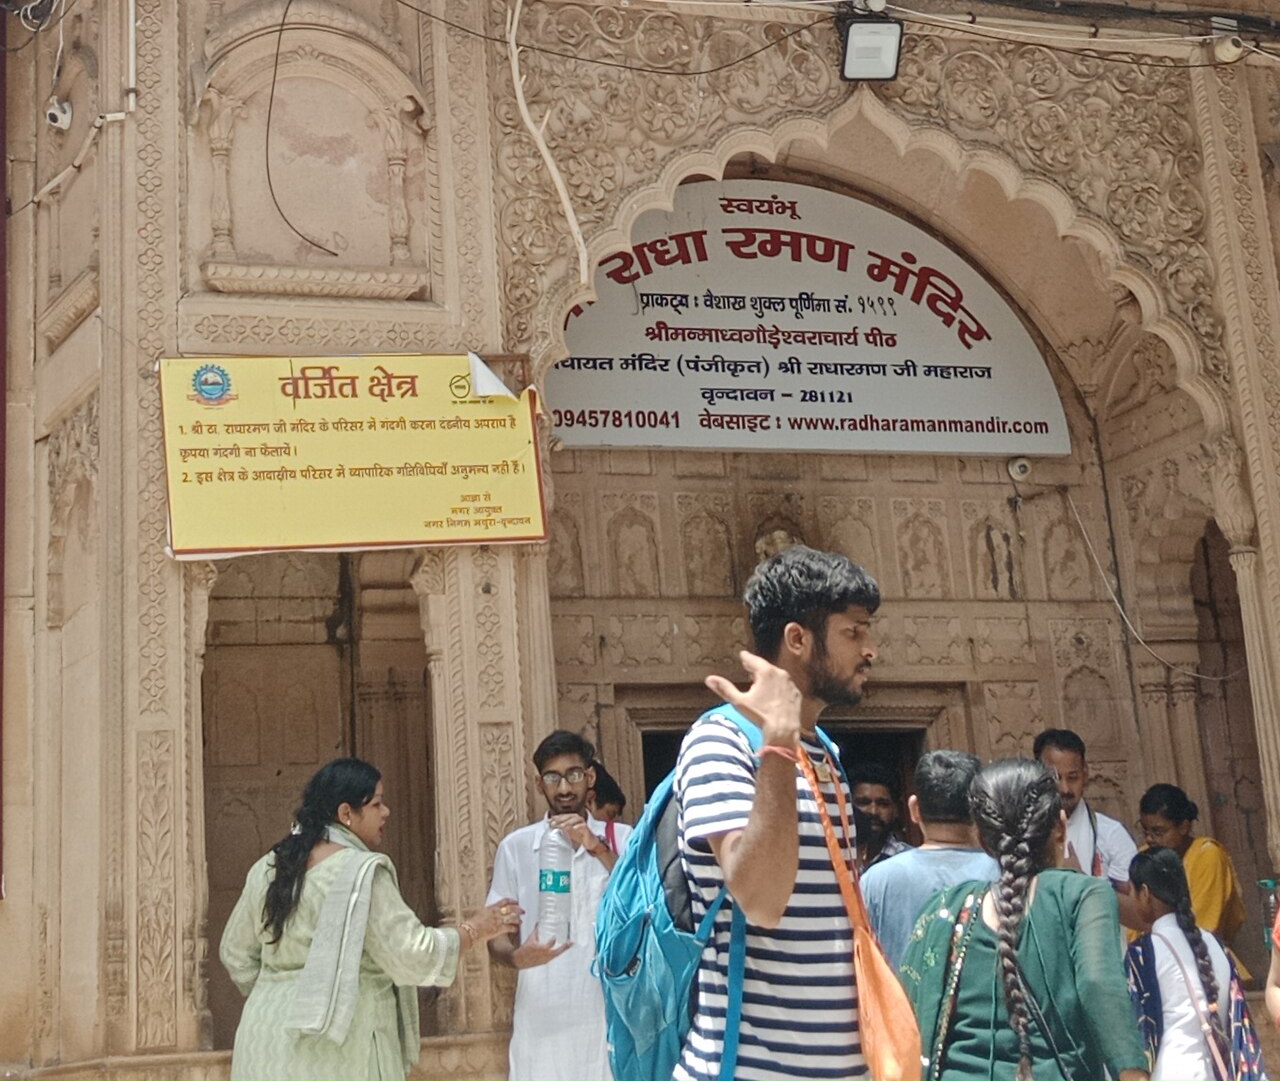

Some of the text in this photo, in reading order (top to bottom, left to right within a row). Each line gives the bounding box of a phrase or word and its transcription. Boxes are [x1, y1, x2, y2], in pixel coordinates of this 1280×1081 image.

[719, 194, 801, 219] स्वयंभू
[598, 227, 992, 350] राधा रमण मंदिर
[750, 295, 786, 317] शुक्ल
[864, 327, 898, 348] पीठ
[619, 353, 671, 371] मंदिर
[677, 353, 769, 378] (पंजीकृत)
[778, 360, 802, 376] श्री
[893, 360, 919, 378] जी
[923, 364, 992, 380] महाराज
[278, 366, 359, 401] वर्जित
[368, 366, 419, 402] क्षेत्र
[699, 387, 775, 405] वृन्दावन
[800, 390, 853, 403] 281121
[179, 425, 187, 435] 1.
[273, 419, 287, 433] जी
[319, 418, 328, 431] के
[332, 417, 364, 432] परिसर
[699, 408, 771, 433] वेबसाइट
[788, 414, 1049, 435] www.radharamanmandir.com
[182, 472, 192, 482] 2.
[195, 471, 213, 485] इस
[238, 467, 248, 480] के
